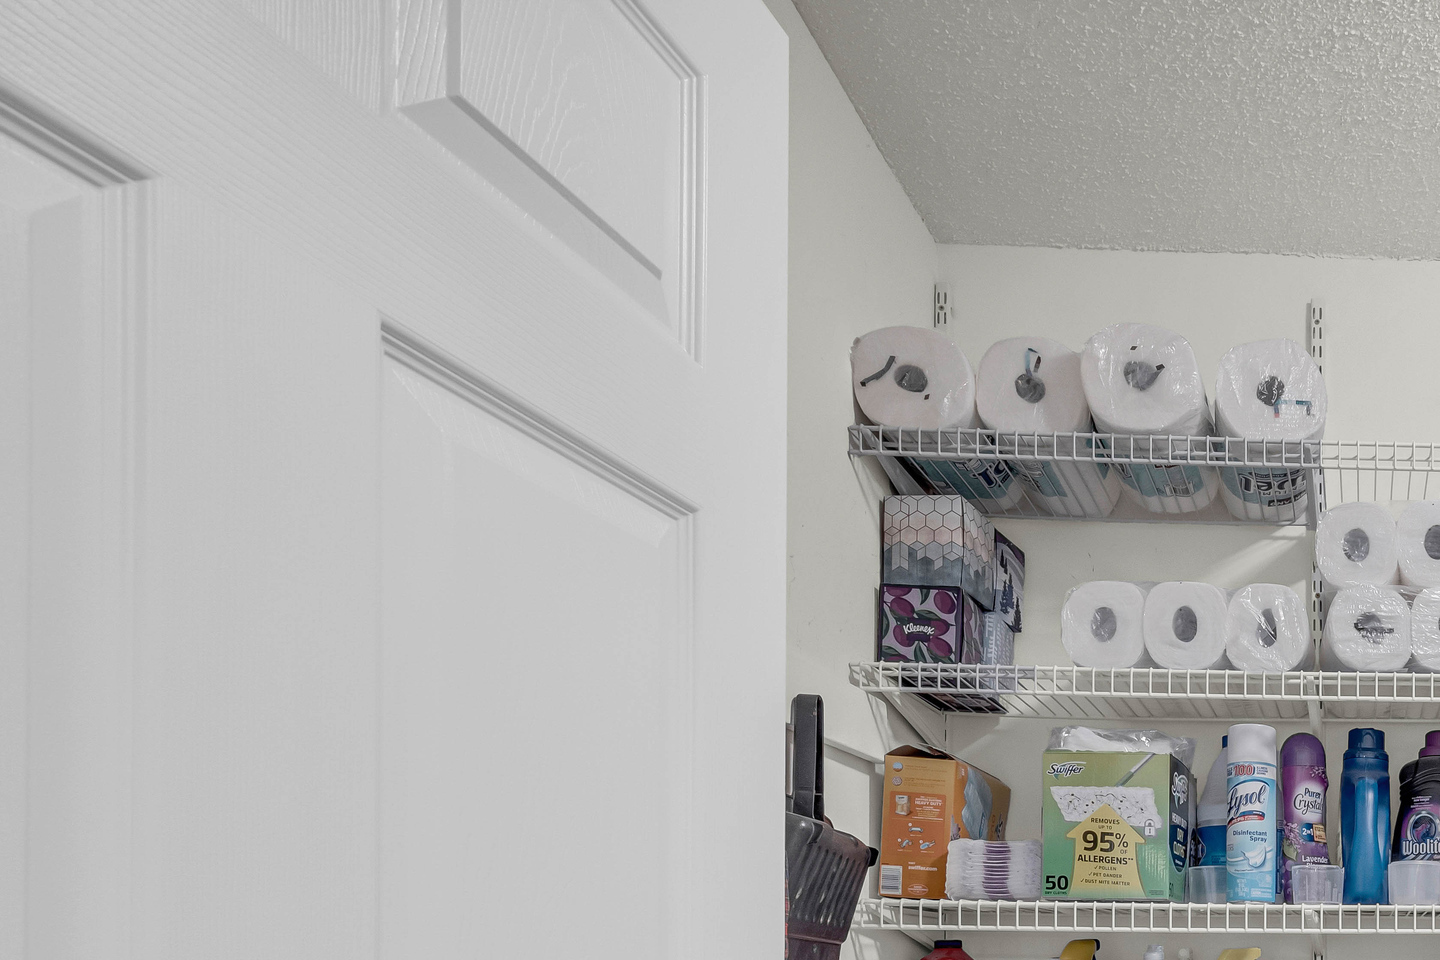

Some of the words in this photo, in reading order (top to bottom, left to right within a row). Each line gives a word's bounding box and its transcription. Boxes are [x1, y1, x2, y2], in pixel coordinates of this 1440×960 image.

[903, 623, 934, 635] Kleenex
[1047, 762, 1085, 778] Swiffer
[1304, 787, 1321, 799] Purex
[1090, 817, 1120, 825] REMOVES
[1082, 830, 1129, 852] 95%
[1301, 855, 1328, 863] Lavender
[1045, 875, 1069, 890] 50
